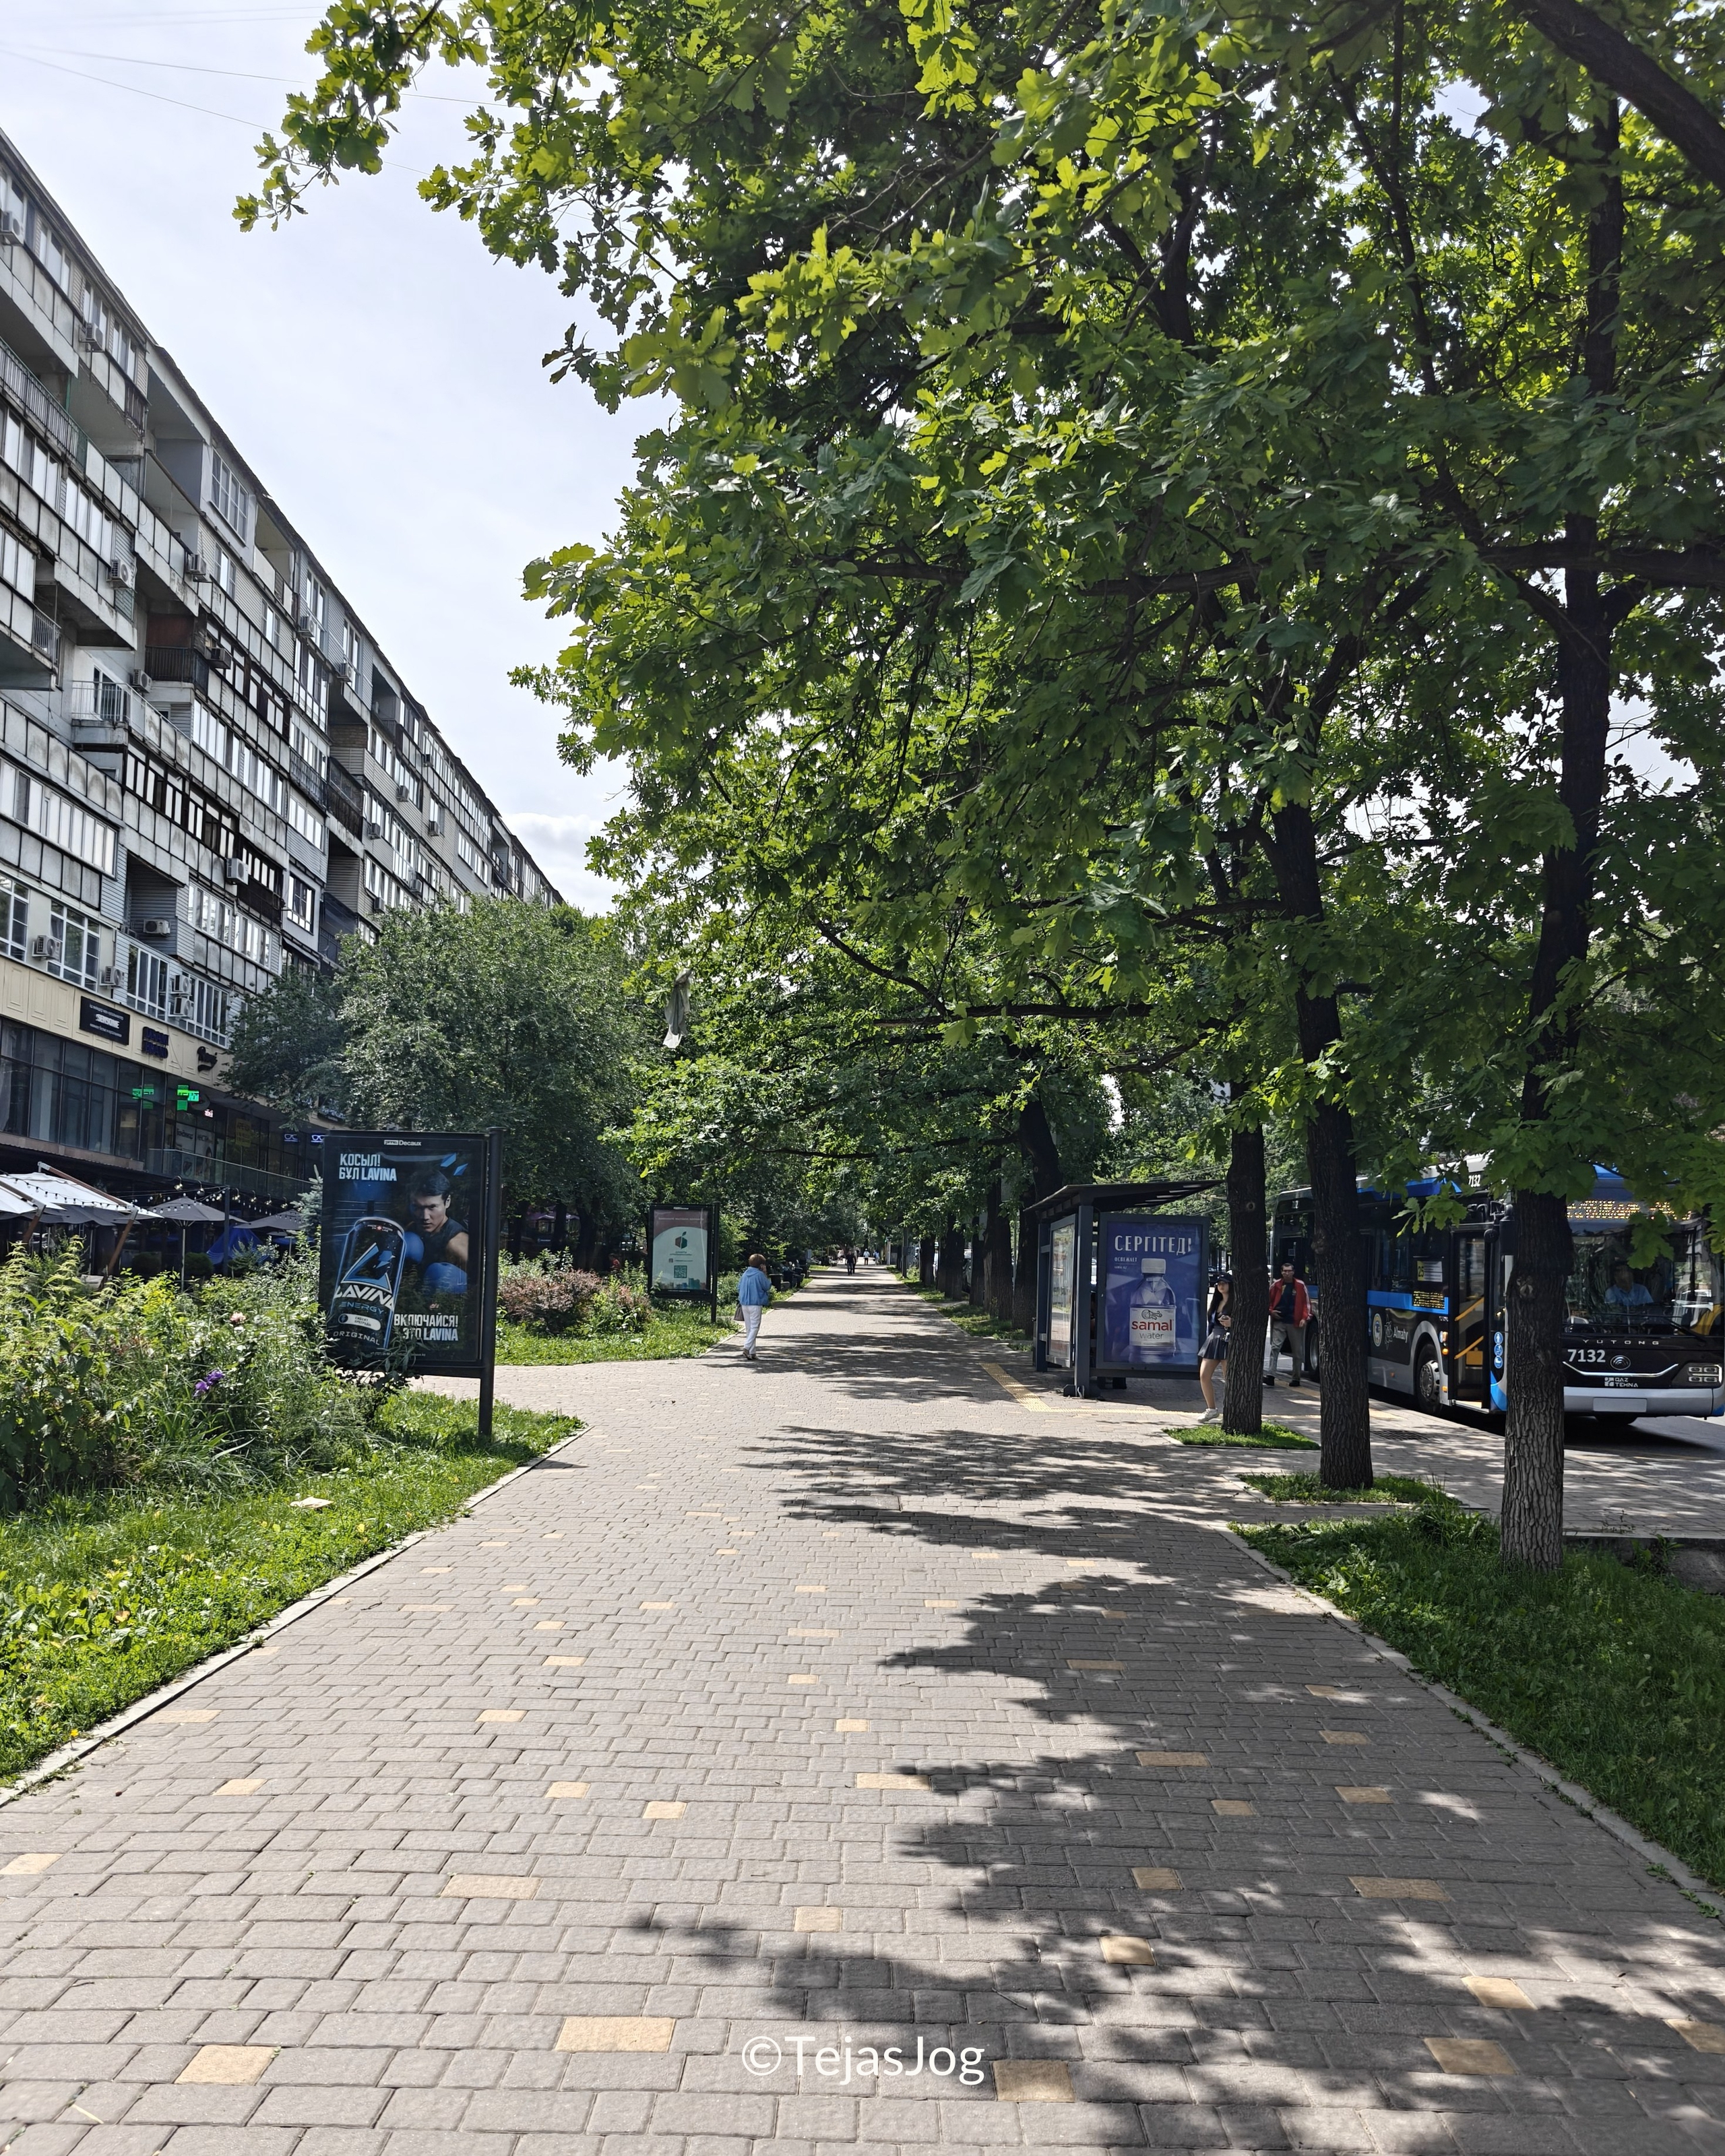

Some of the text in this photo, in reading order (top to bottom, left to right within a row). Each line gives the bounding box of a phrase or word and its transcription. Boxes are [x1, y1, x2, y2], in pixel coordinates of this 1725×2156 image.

[340, 1153, 381, 1167] КОСЫЛ!
[339, 1167, 397, 1181] БҰЛ LAVINA
[1468, 1174, 1481, 1188] 7132
[334, 1284, 394, 1312] LAVINA
[338, 1301, 384, 1314] ENERGY
[394, 1312, 458, 1327] ВКЛЮЧАЙСЯ!
[1131, 1319, 1172, 1331] samal
[333, 1331, 380, 1345] ORIGINAL
[423, 1328, 458, 1341] LAVINA
[1393, 1326, 1408, 1343] Almaty
[1567, 1349, 1606, 1363] 7132
